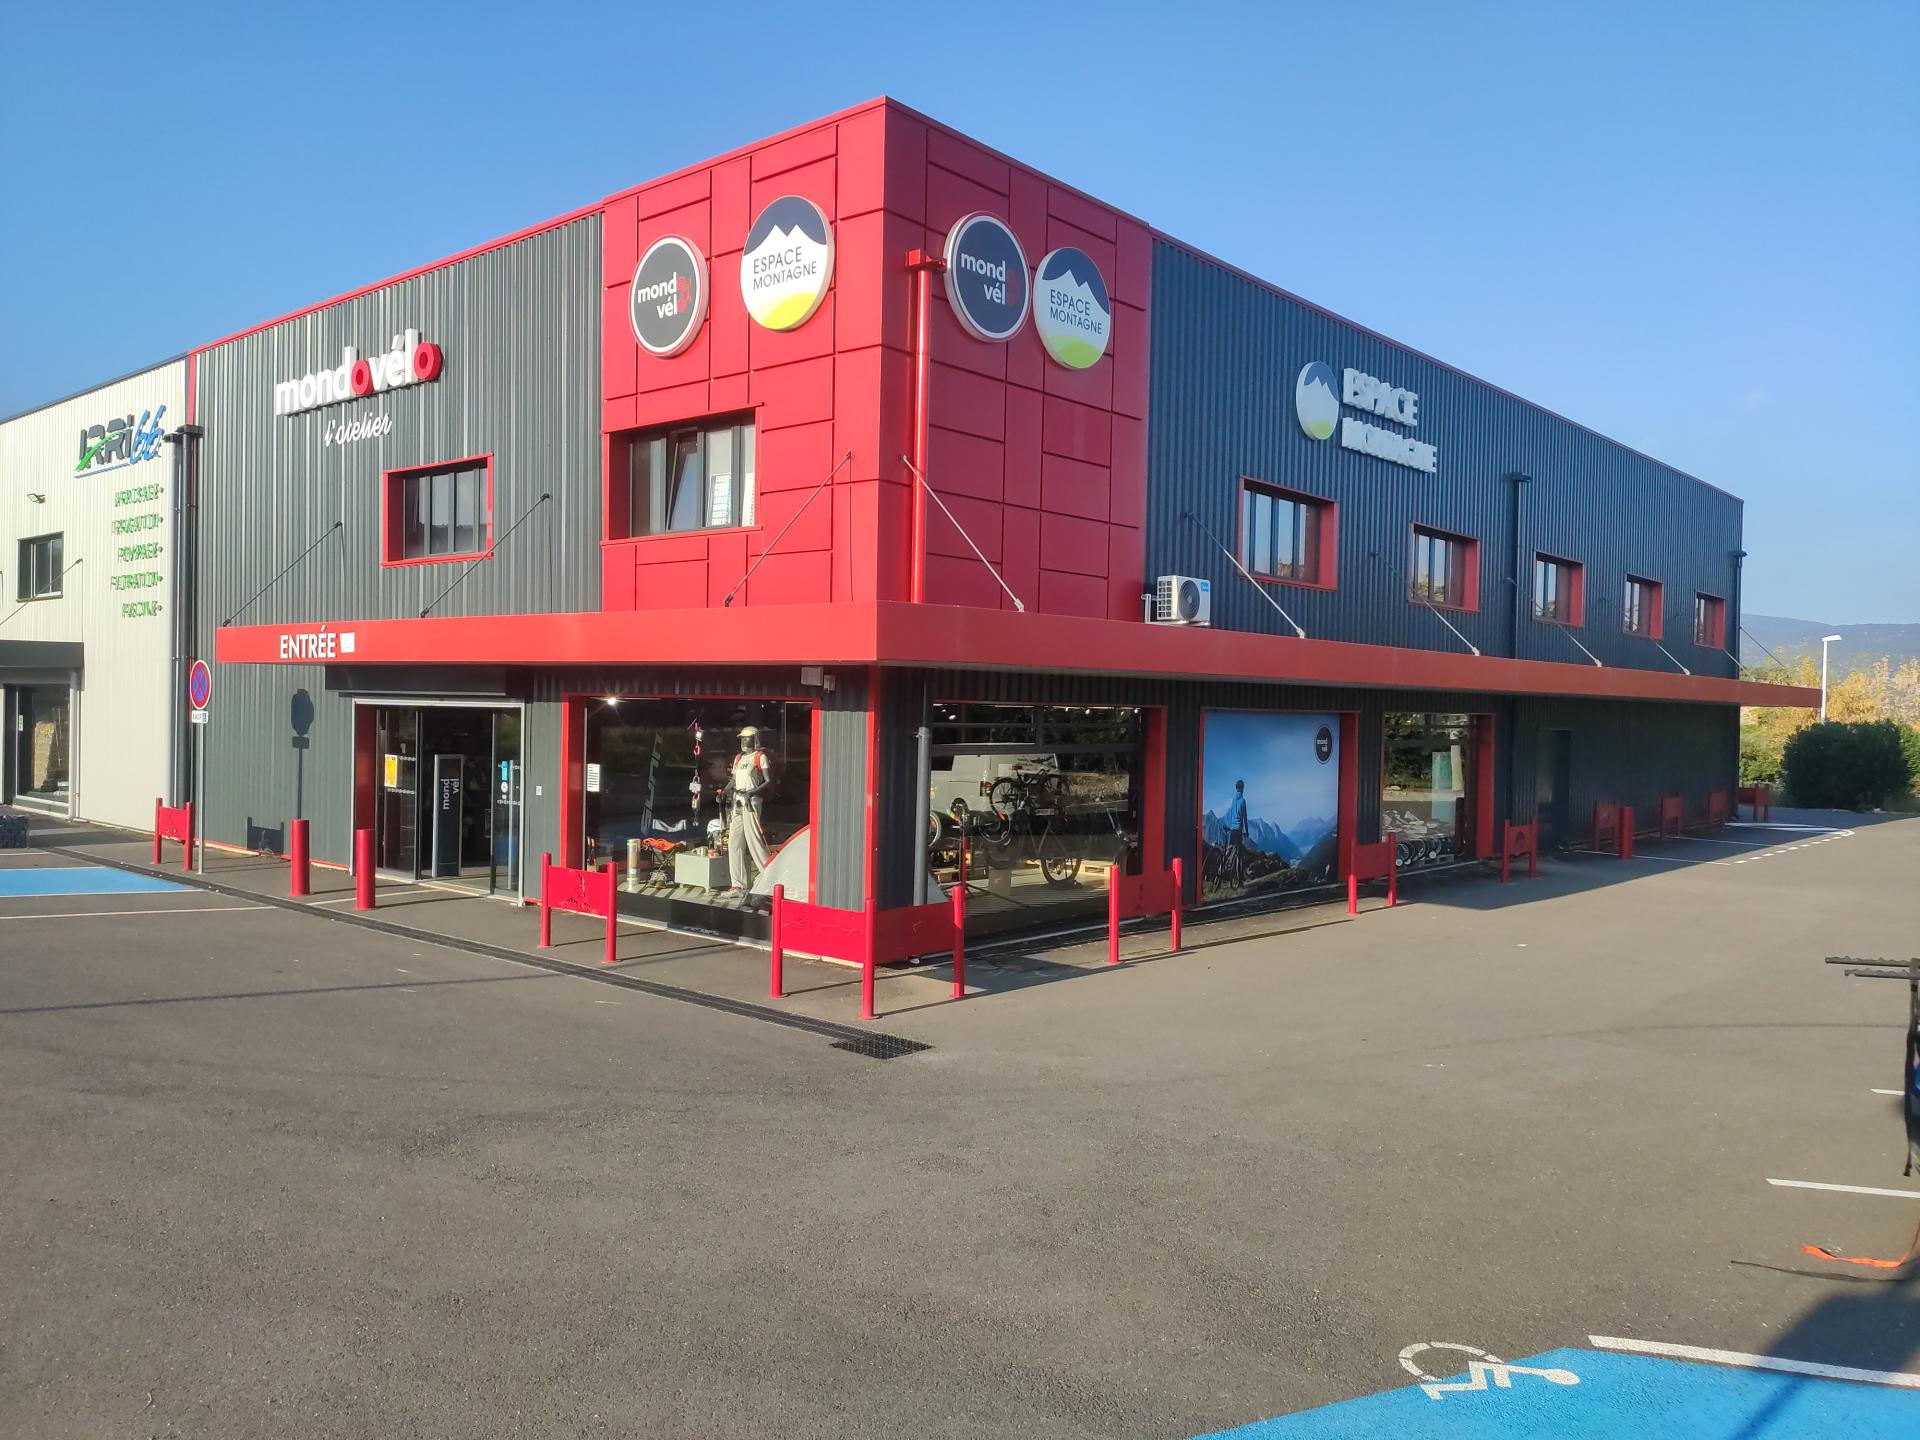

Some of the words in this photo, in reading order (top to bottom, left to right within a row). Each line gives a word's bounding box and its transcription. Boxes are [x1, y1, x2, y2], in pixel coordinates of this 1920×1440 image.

[753, 246, 802, 275] ESPACE
[753, 261, 817, 290] MONTAGNE
[1050, 288, 1091, 317] ESPACE
[1050, 307, 1102, 335] MONTAGNE
[275, 328, 443, 416] mondovélo
[1342, 367, 1418, 427] ESPACE
[324, 411, 393, 447] l'atelier
[280, 625, 337, 659] ENTRÉE
